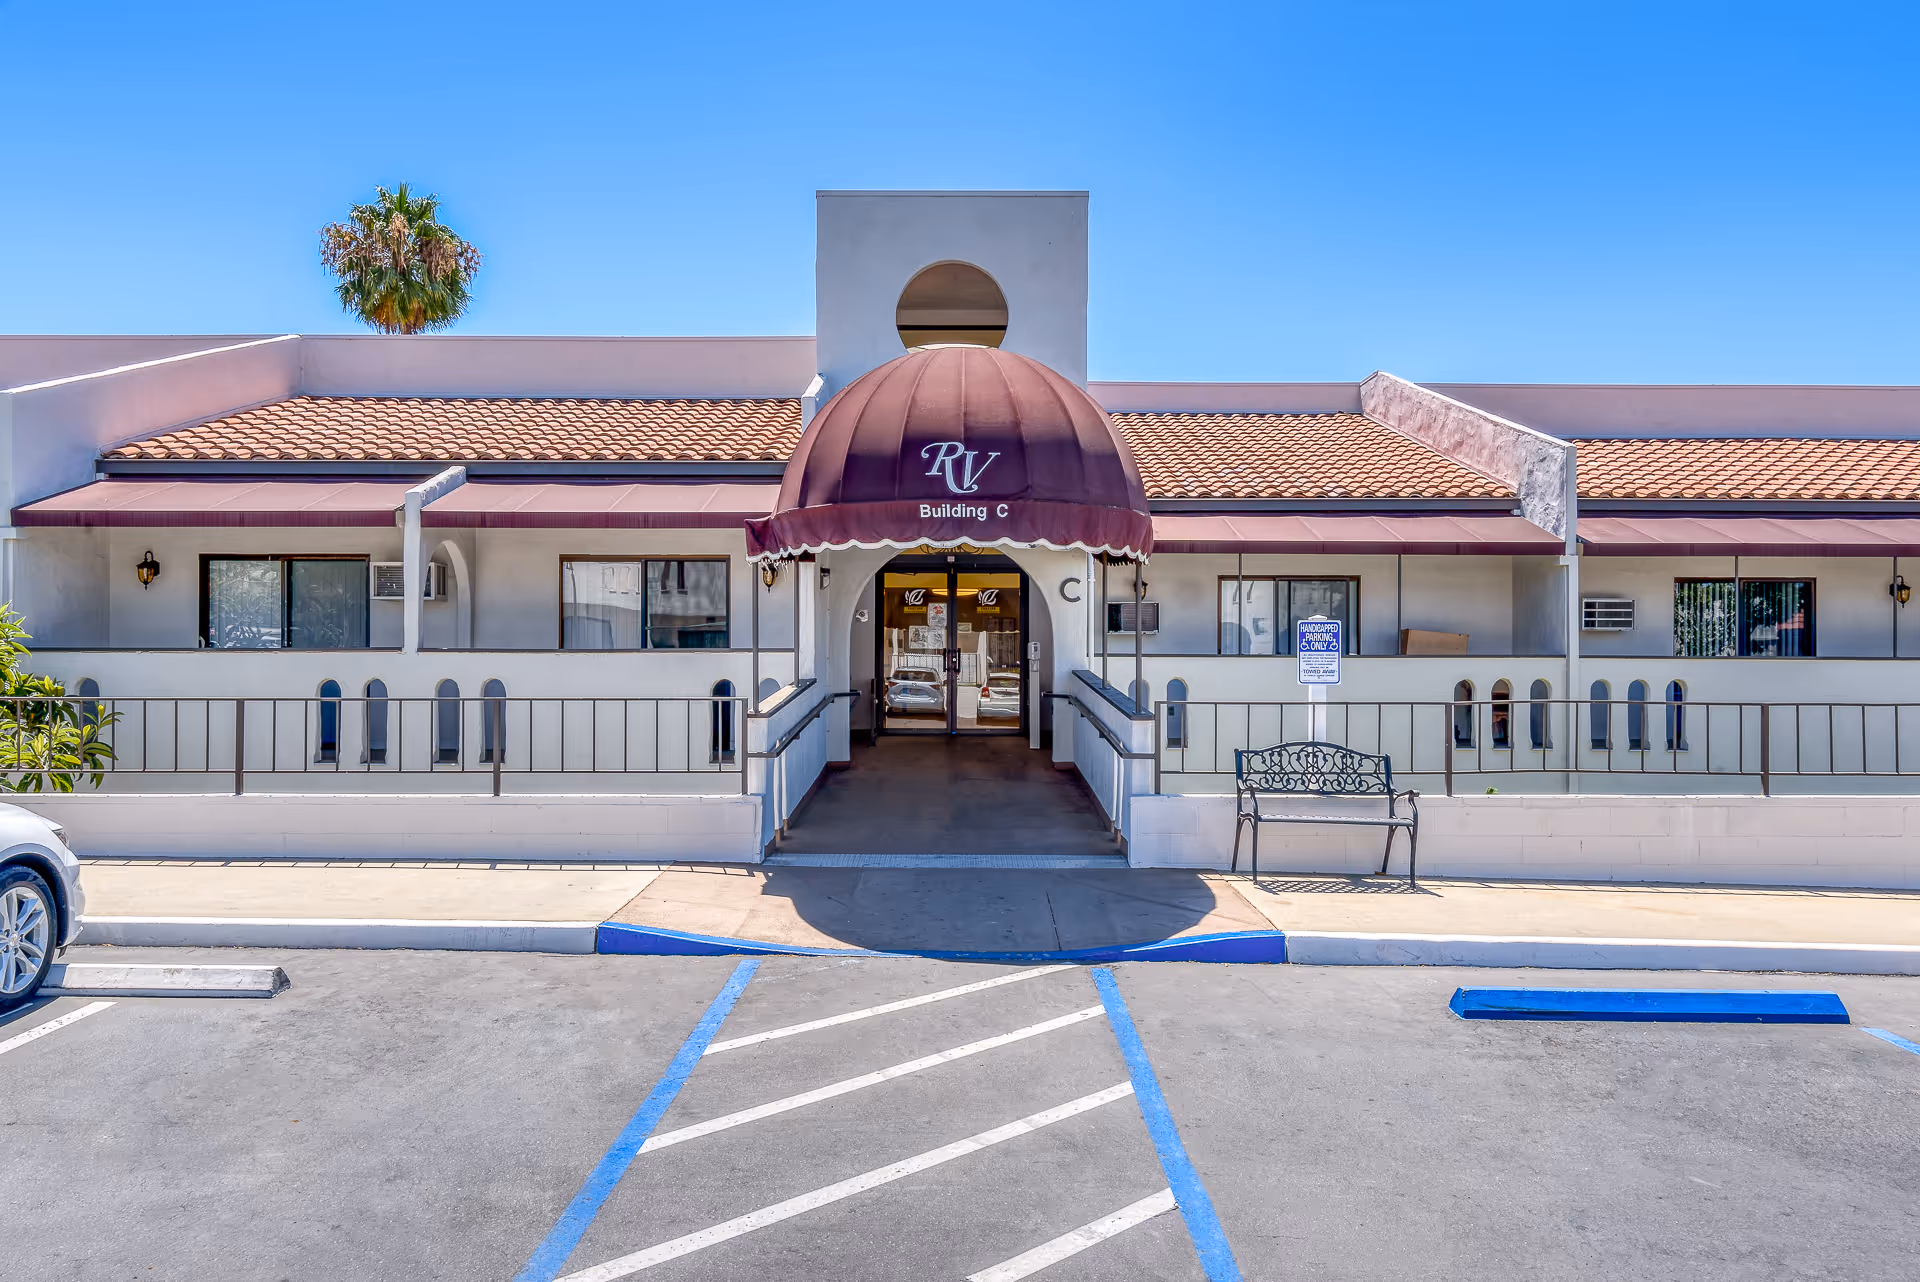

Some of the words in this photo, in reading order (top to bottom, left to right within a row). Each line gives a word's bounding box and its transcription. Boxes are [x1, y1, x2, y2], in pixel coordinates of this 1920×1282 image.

[921, 441, 1001, 494] RV
[920, 504, 987, 521] Building
[996, 503, 1009, 518] C
[1059, 577, 1081, 603] C
[1300, 623, 1338, 632] HANDICAPPED
[1305, 633, 1333, 641] PARKING
[1310, 641, 1328, 650] ONLY
